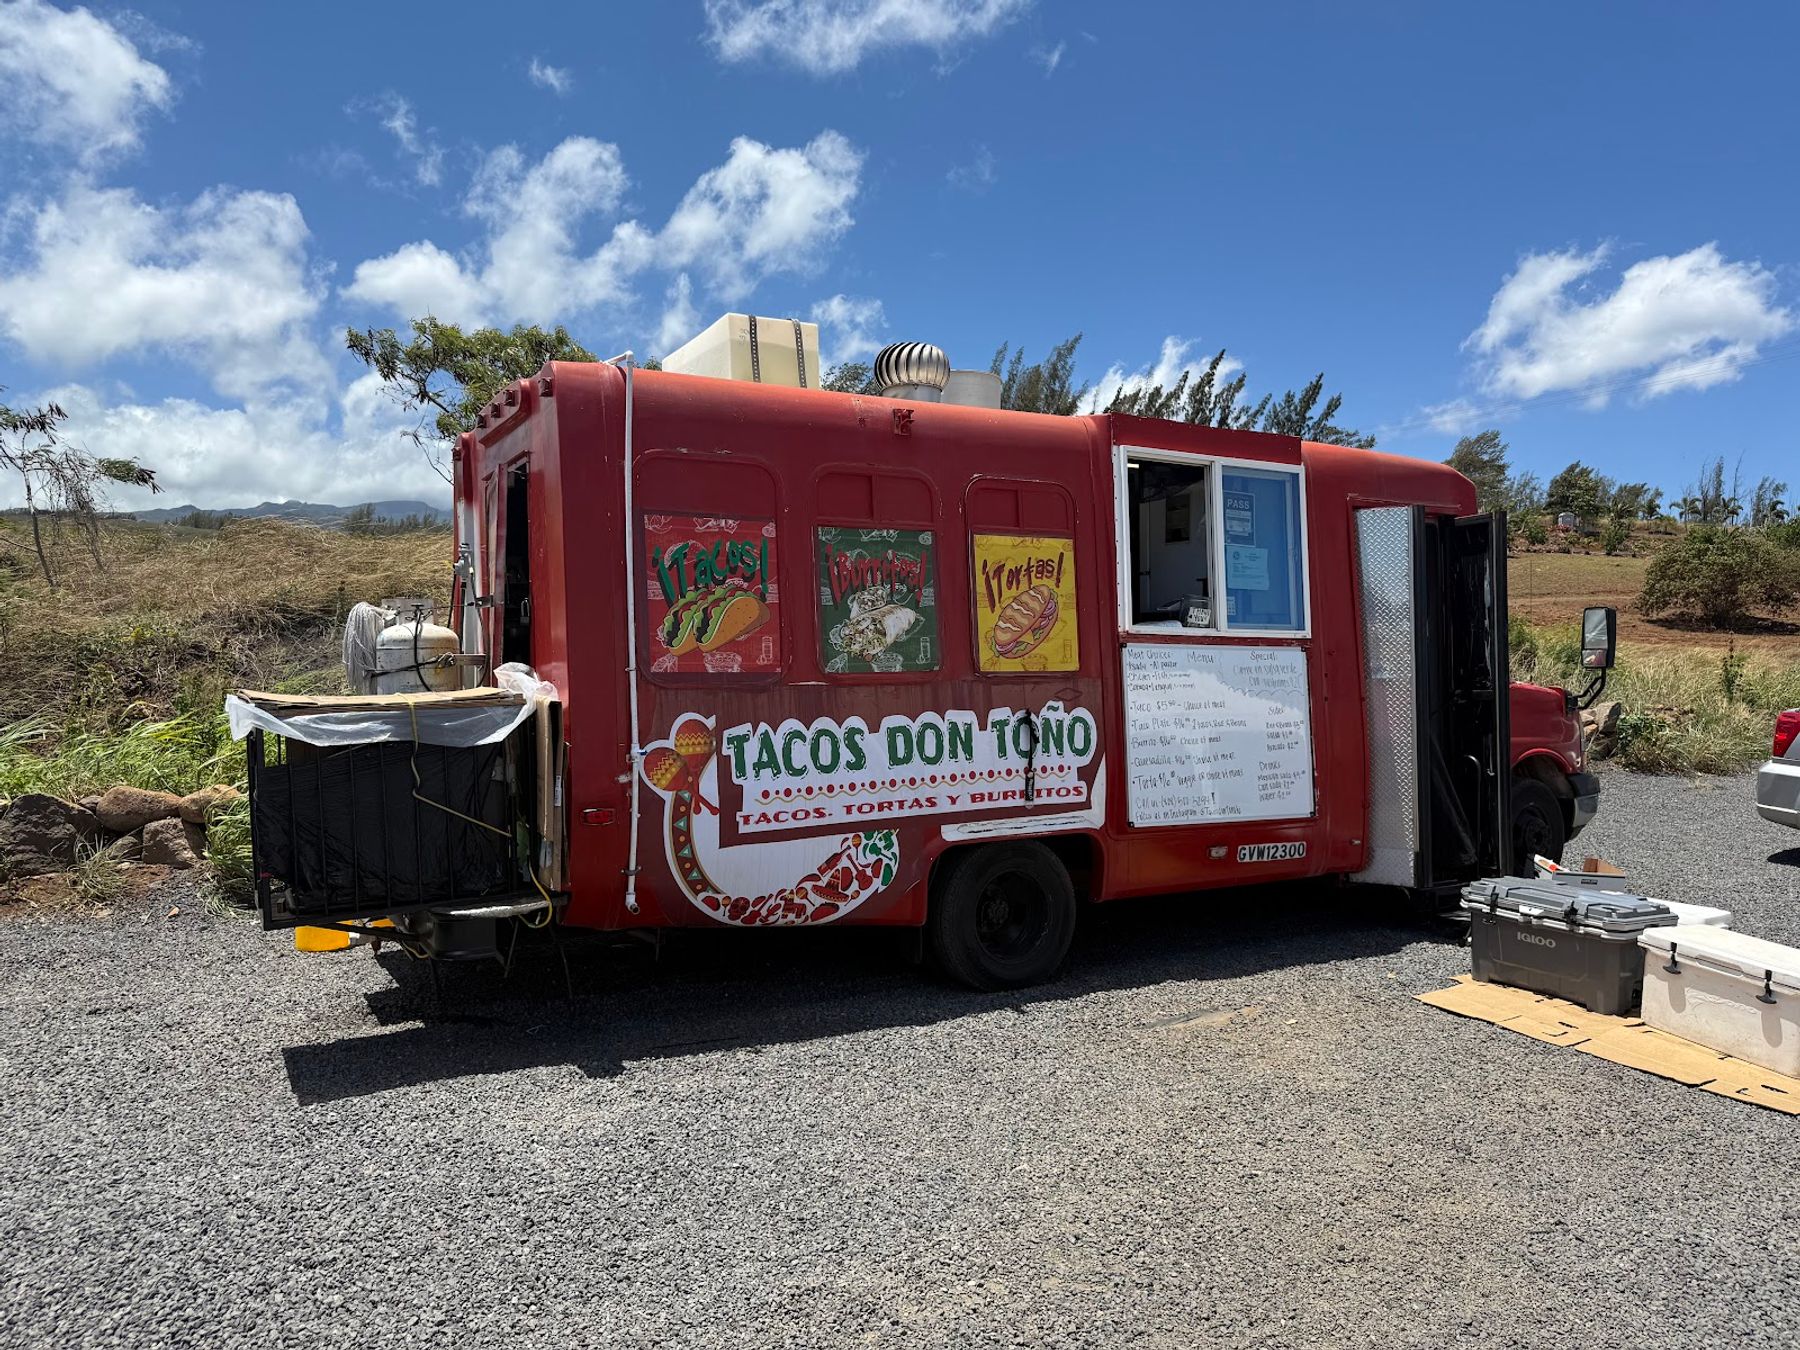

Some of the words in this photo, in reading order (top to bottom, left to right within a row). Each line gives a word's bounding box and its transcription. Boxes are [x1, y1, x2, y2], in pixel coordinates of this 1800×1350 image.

[1227, 498, 1250, 510] PASS
[982, 551, 1065, 614] ¡Tortas!
[1186, 650, 1215, 664] Menu
[726, 726, 867, 781] TACOS
[885, 718, 975, 770] DON
[990, 704, 1092, 761] TOÑO
[843, 796, 939, 816] TORTAS
[947, 794, 961, 806] Y
[1239, 842, 1306, 861] GVW12300
[1517, 931, 1557, 949] IGLOO
